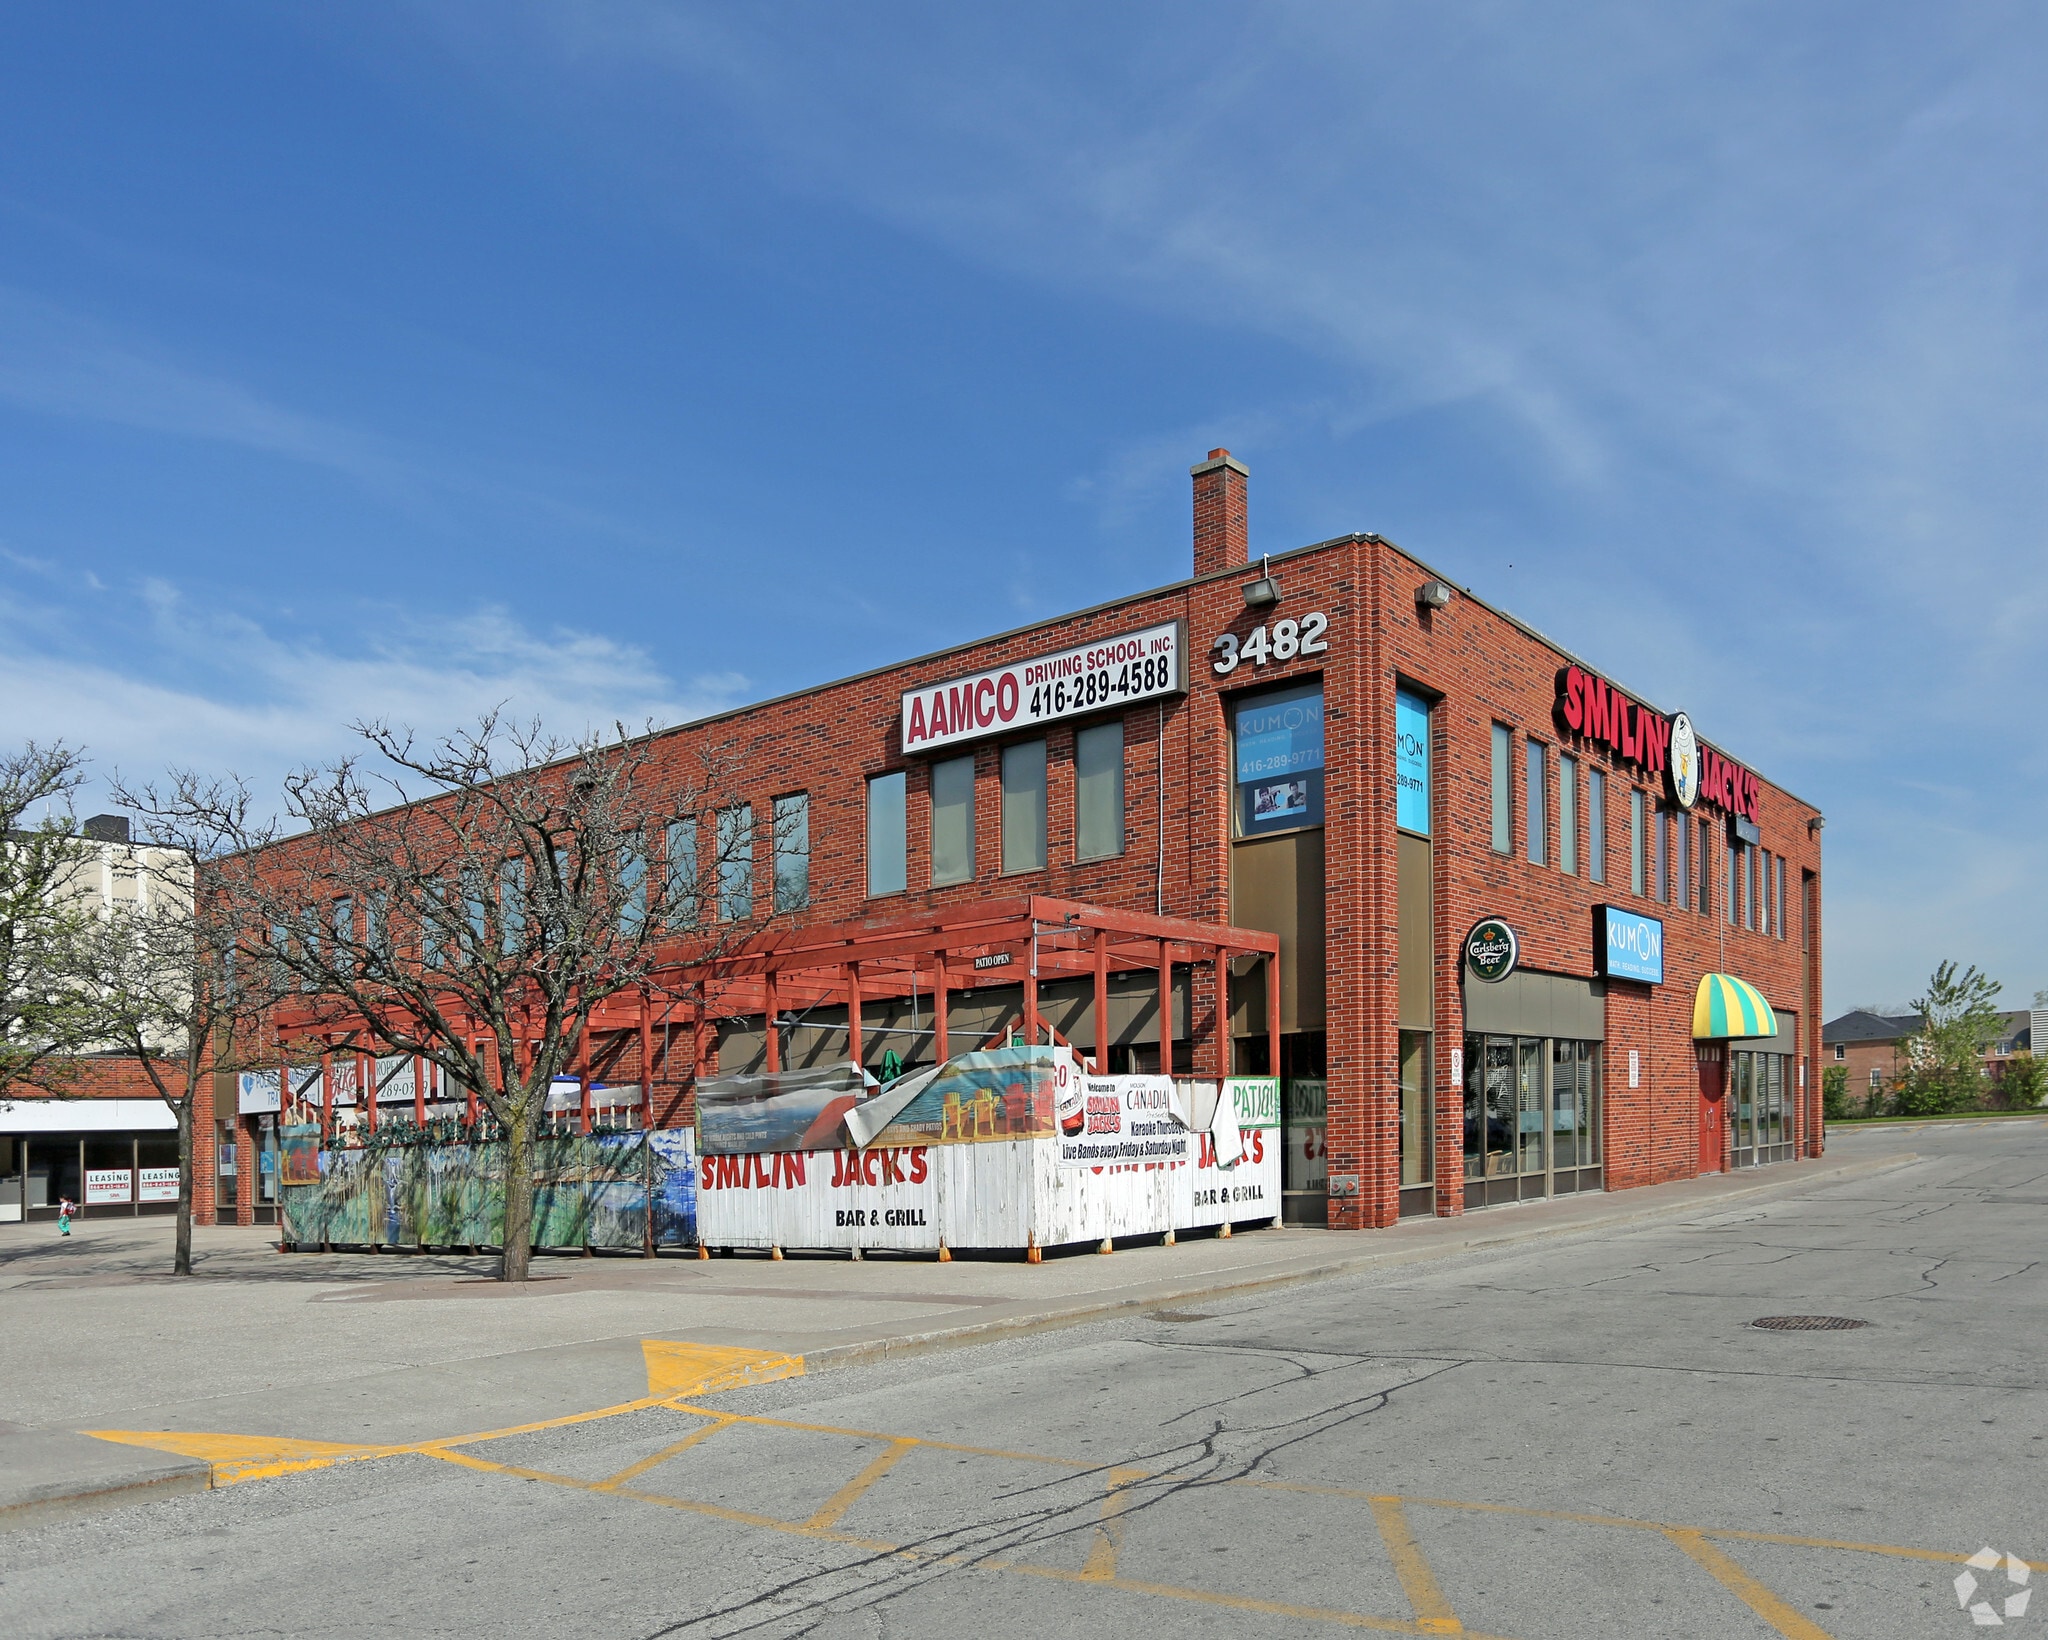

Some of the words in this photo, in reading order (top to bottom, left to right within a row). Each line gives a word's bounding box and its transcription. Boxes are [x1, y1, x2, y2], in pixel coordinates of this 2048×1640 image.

[1213, 611, 1328, 674] 3482
[1025, 655, 1083, 686] DRIVING
[1086, 638, 1146, 671] SCHOOL
[1150, 636, 1174, 655] INC.
[1030, 655, 1169, 717] 416-289-4588
[907, 672, 1020, 744] AAMCO
[1240, 706, 1320, 737] KUMON
[1562, 665, 1670, 772] SMILIN'
[1700, 745, 1760, 823] JACK'S
[1241, 748, 1320, 774] 416-289-9771
[1470, 939, 1510, 956] Carlsberg
[1608, 921, 1660, 960] KUMON
[975, 956, 993, 969] PATIO
[993, 953, 1010, 966] OPEN
[1479, 955, 1500, 965] Beer
[1087, 1082, 1110, 1092] Welcome
[1109, 1083, 1116, 1092] to
[910, 1123, 925, 1133] SHADY
[925, 1122, 942, 1132] PATIOS
[1087, 1115, 1122, 1135] JACK'S
[1130, 1120, 1156, 1136] Karaoke
[1156, 1120, 1185, 1135] Thursdays
[1062, 1143, 1077, 1160] Live
[1078, 1143, 1100, 1159] Bands
[1100, 1144, 1120, 1159] every
[1119, 1141, 1140, 1158] Friday
[1139, 1143, 1144, 1156] &
[1145, 1140, 1172, 1156] Saturday
[1171, 1138, 1187, 1155] Night
[701, 1150, 814, 1190] SMILIN'
[831, 1146, 928, 1188] JACK'S
[1194, 1189, 1217, 1207] BAR
[1220, 1187, 1230, 1204] &
[1232, 1184, 1264, 1203] GRILL
[836, 1209, 865, 1227] BAR
[869, 1209, 880, 1226] &
[884, 1208, 927, 1227] GRILL
